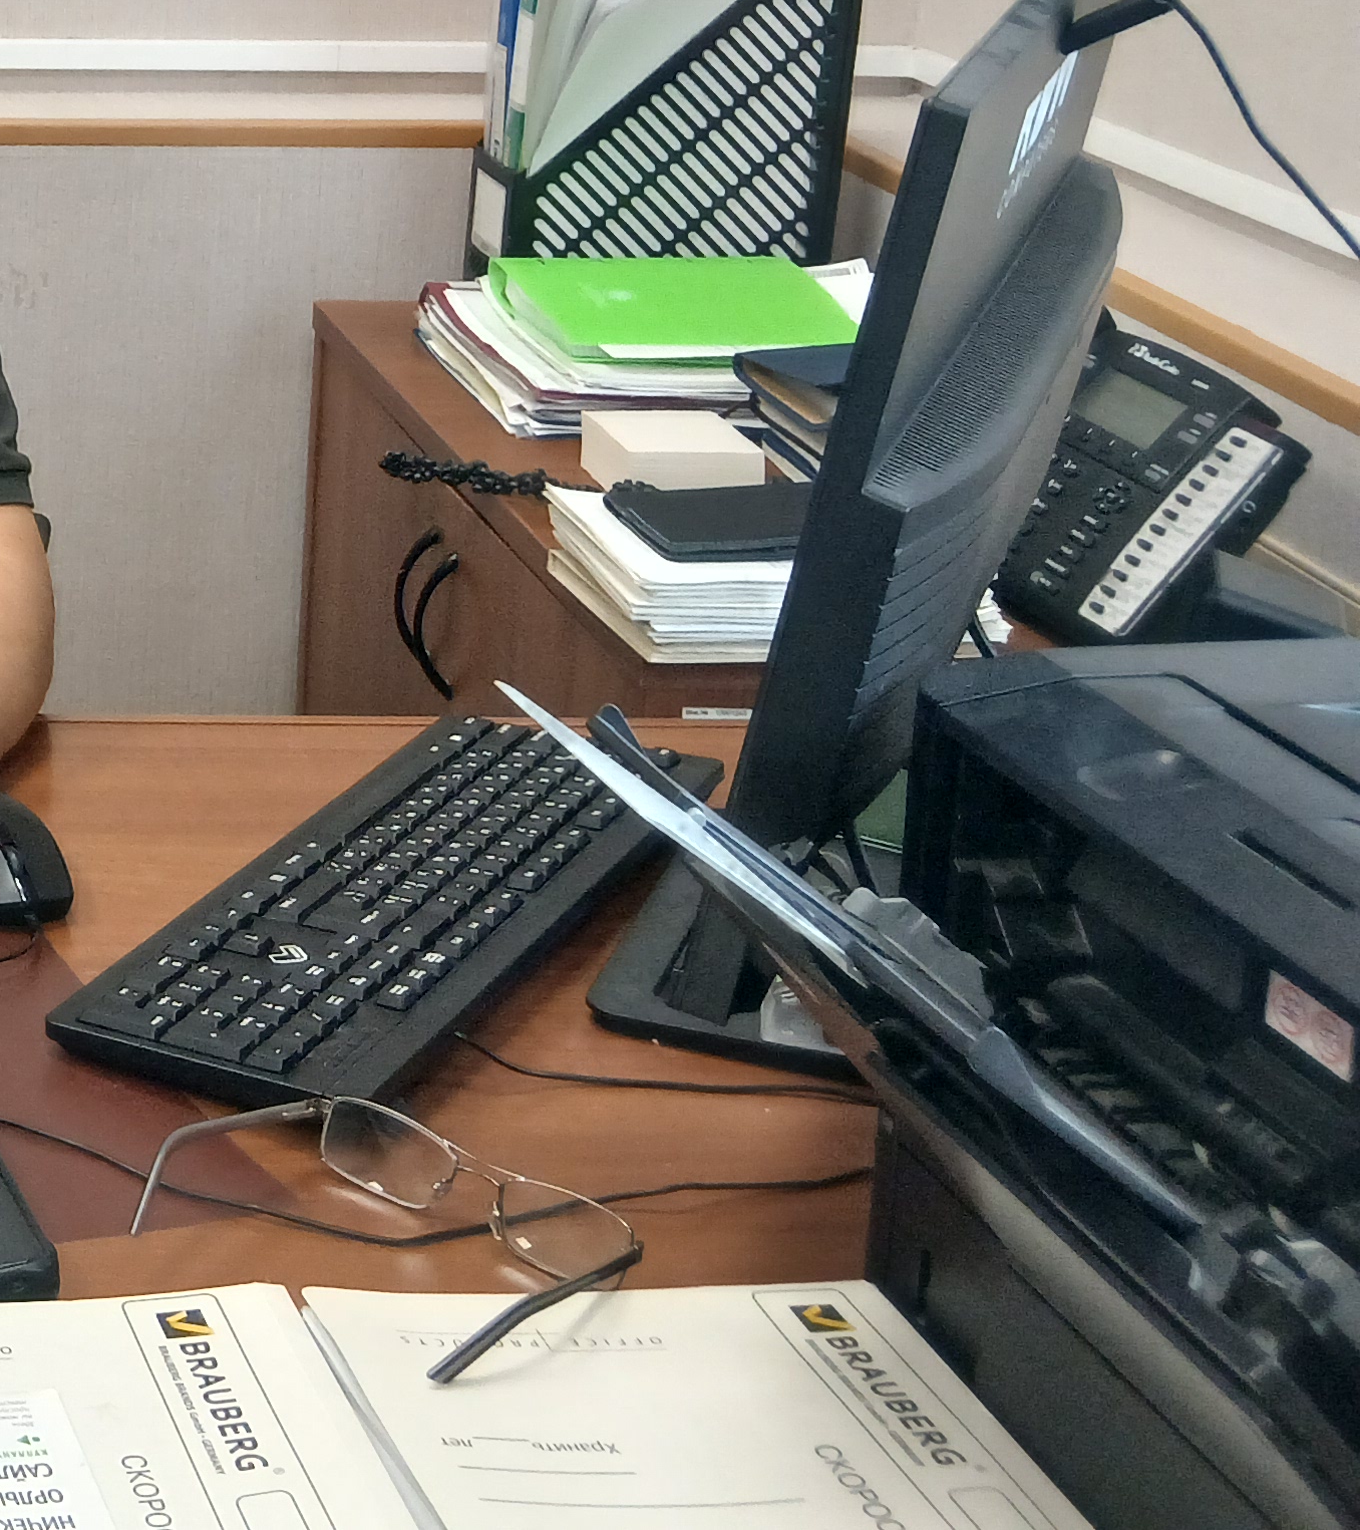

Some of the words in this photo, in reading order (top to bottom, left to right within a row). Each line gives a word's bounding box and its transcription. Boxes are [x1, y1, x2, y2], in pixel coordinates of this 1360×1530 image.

[400, 1335, 541, 1348] PROUCTS
[158, 1345, 182, 1382] BRAUBERG
[179, 1341, 269, 1472] BRAUBERG
[826, 1336, 967, 1466] BRAUBERG
[441, 1436, 474, 1449] лет
[532, 1439, 622, 1454] Хранить
[121, 1455, 176, 1530] СКОРО
